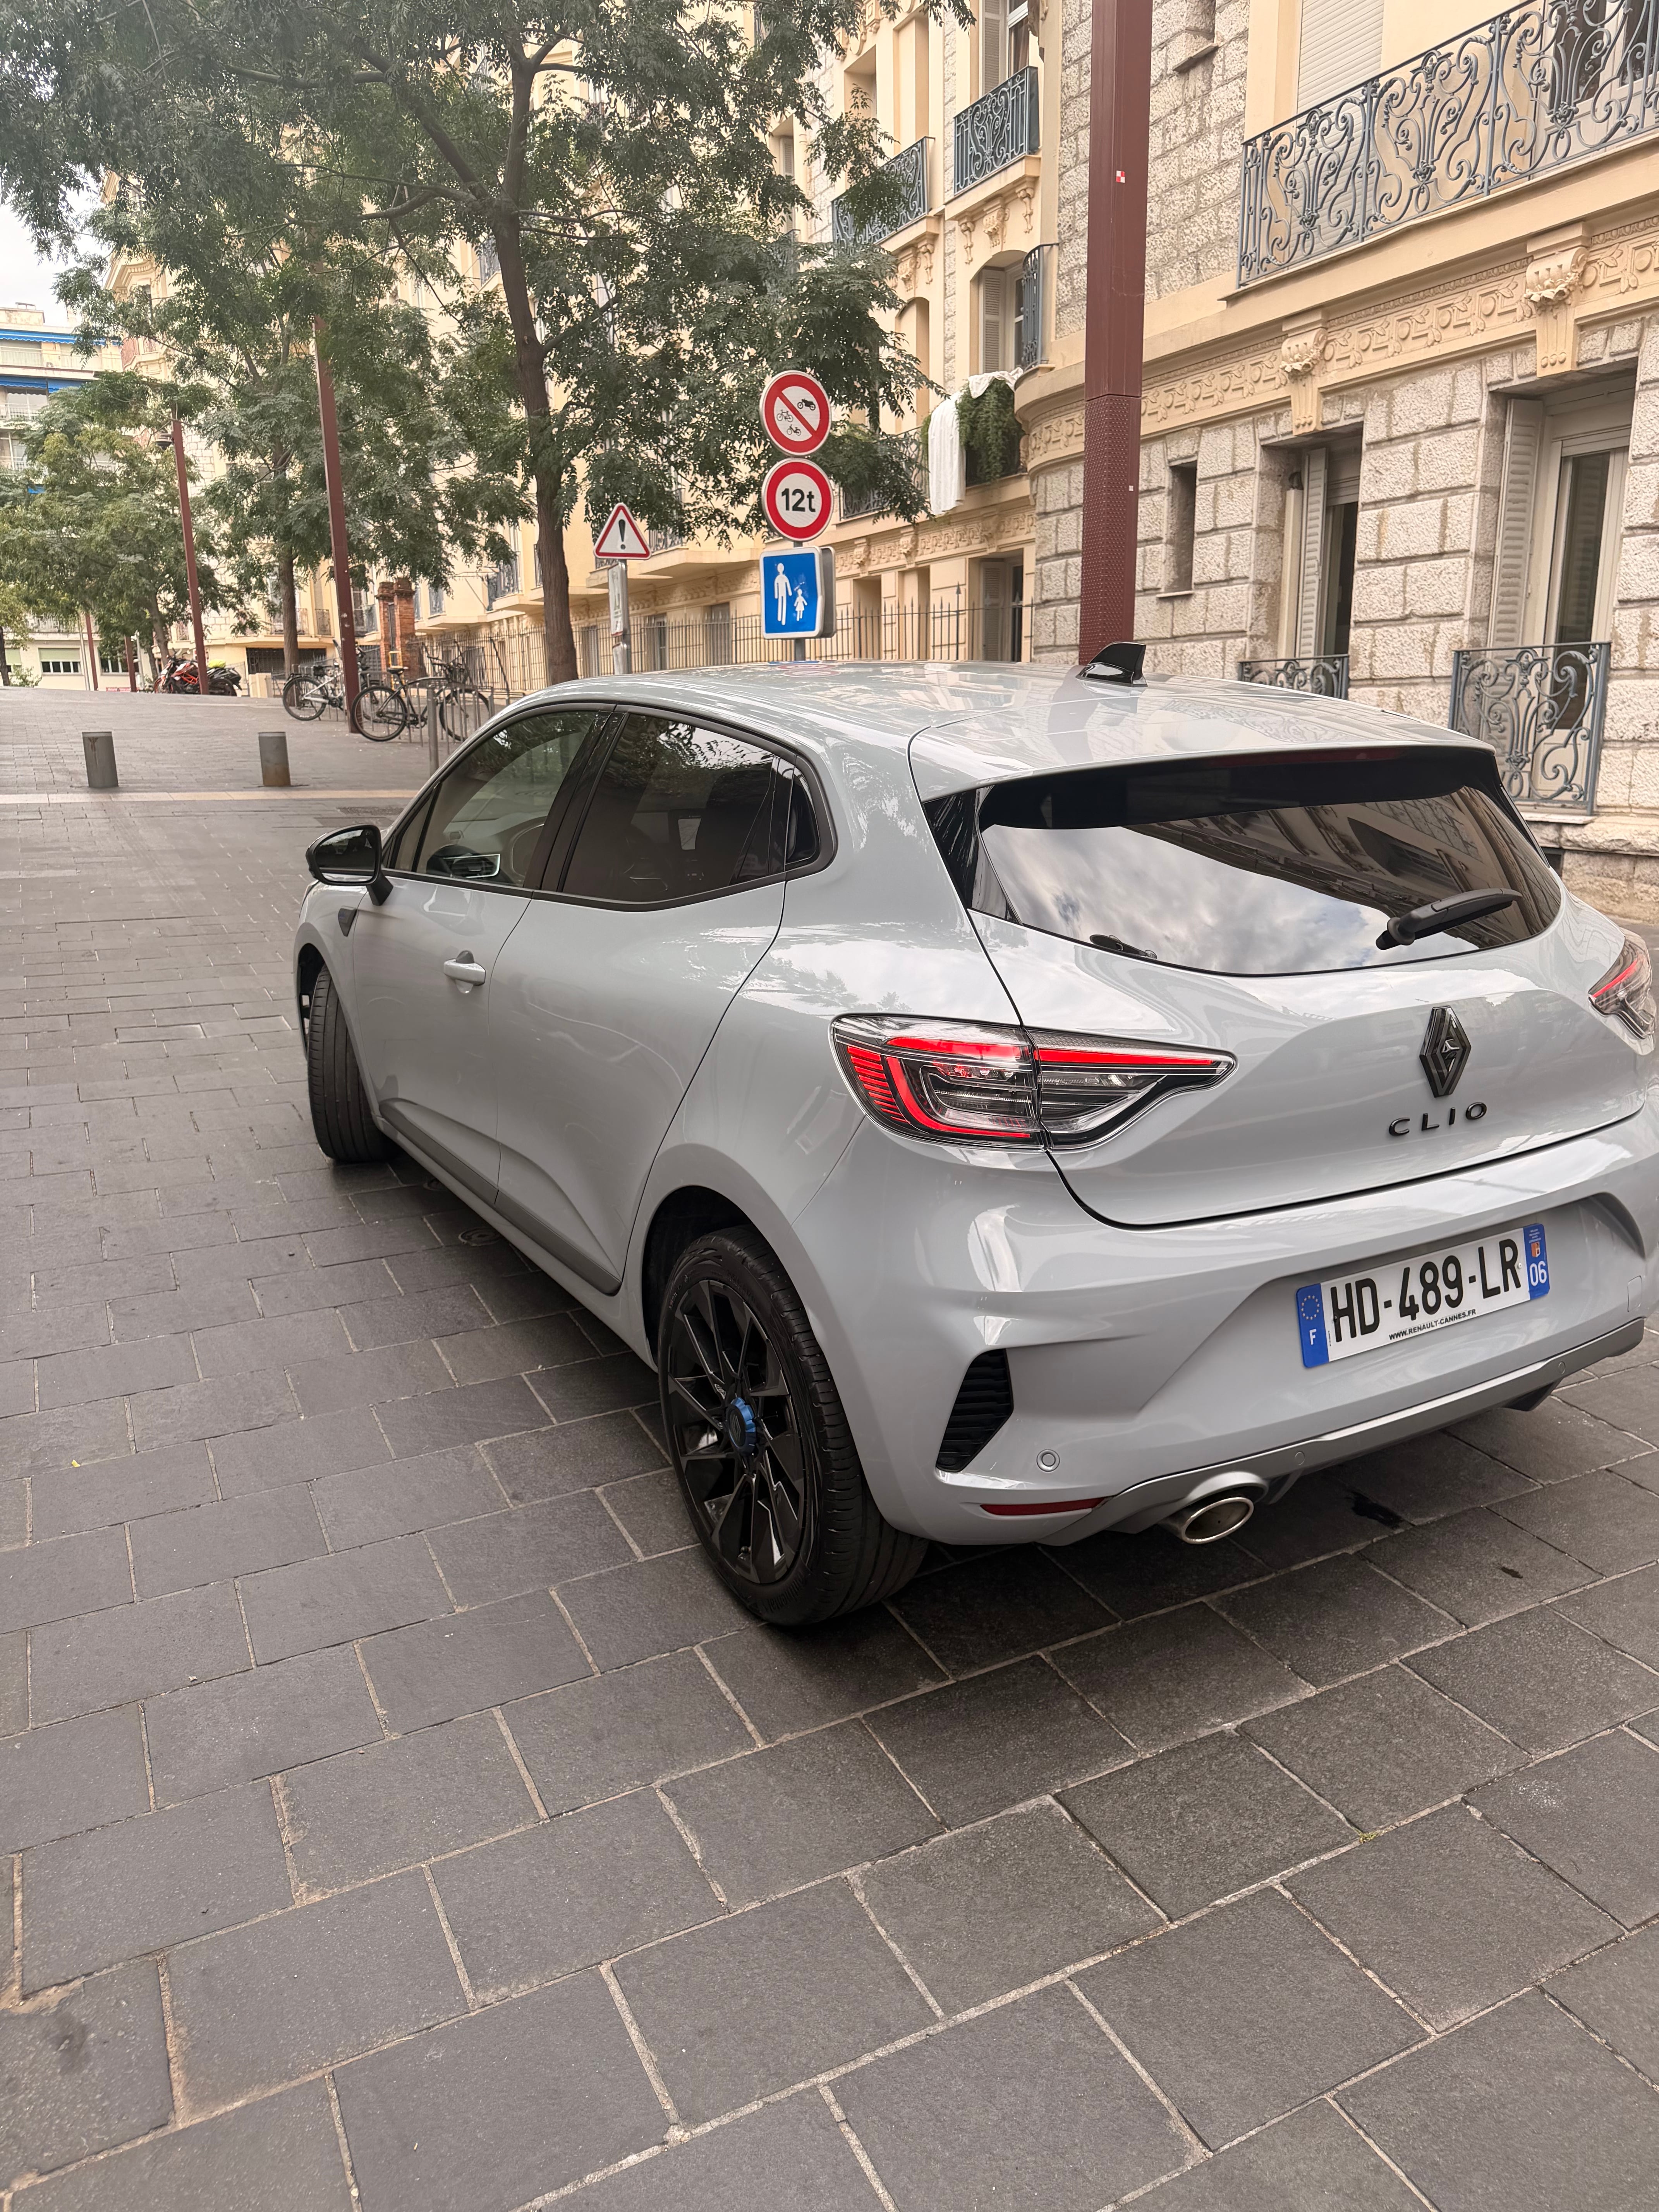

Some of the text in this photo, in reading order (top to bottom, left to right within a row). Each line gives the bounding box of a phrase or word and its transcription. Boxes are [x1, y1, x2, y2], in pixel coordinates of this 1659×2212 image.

[781, 488, 816, 512] 12t
[1389, 1102, 1487, 1136] CLIO
[1530, 1261, 1547, 1286] 06
[1331, 1238, 1521, 1343] HD-489-LR
[1309, 1329, 1317, 1345] F
[1389, 1309, 1476, 1340] WWW.RENAULT-CANNES.FR
